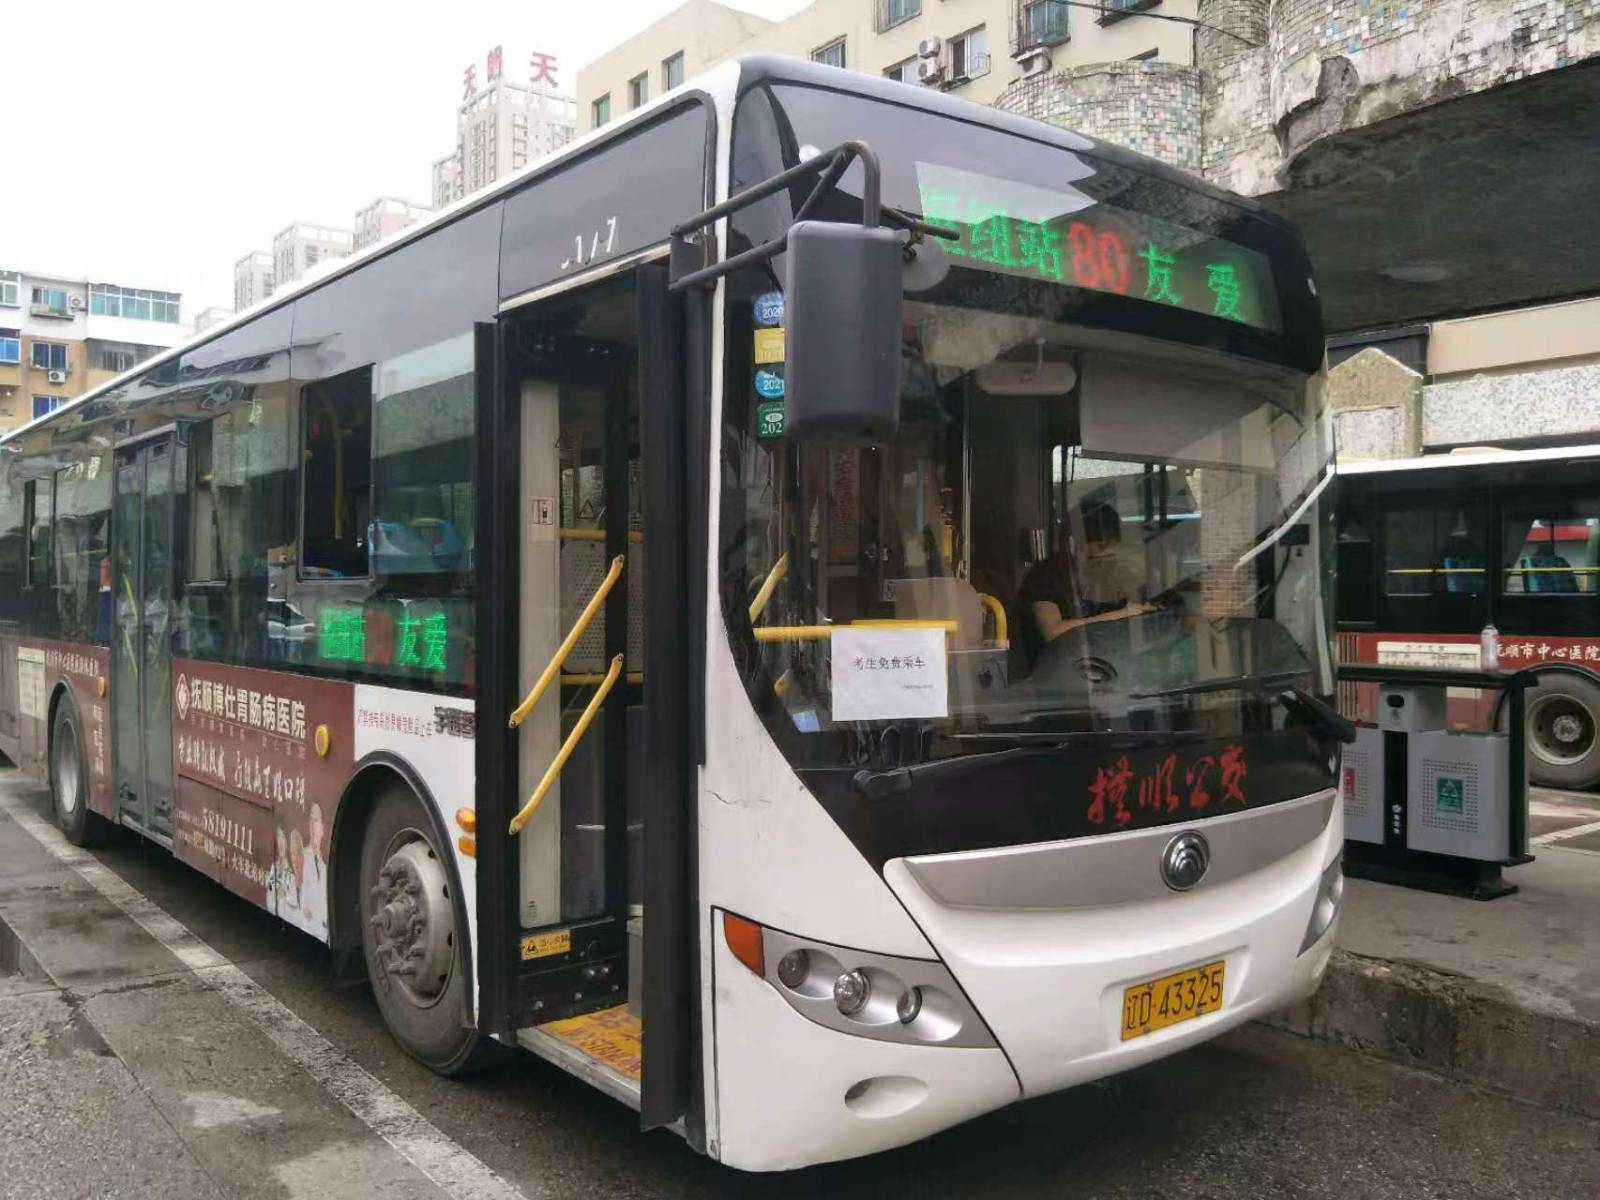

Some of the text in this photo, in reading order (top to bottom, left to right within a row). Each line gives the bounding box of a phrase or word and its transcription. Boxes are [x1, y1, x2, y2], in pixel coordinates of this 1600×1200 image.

[529, 51, 559, 88] 天
[1067, 221, 1128, 295] 80
[1137, 241, 1247, 323] 友爱
[189, 681, 307, 740] 抚顺博仕胃肠病医院
[200, 807, 254, 855] 58191111
